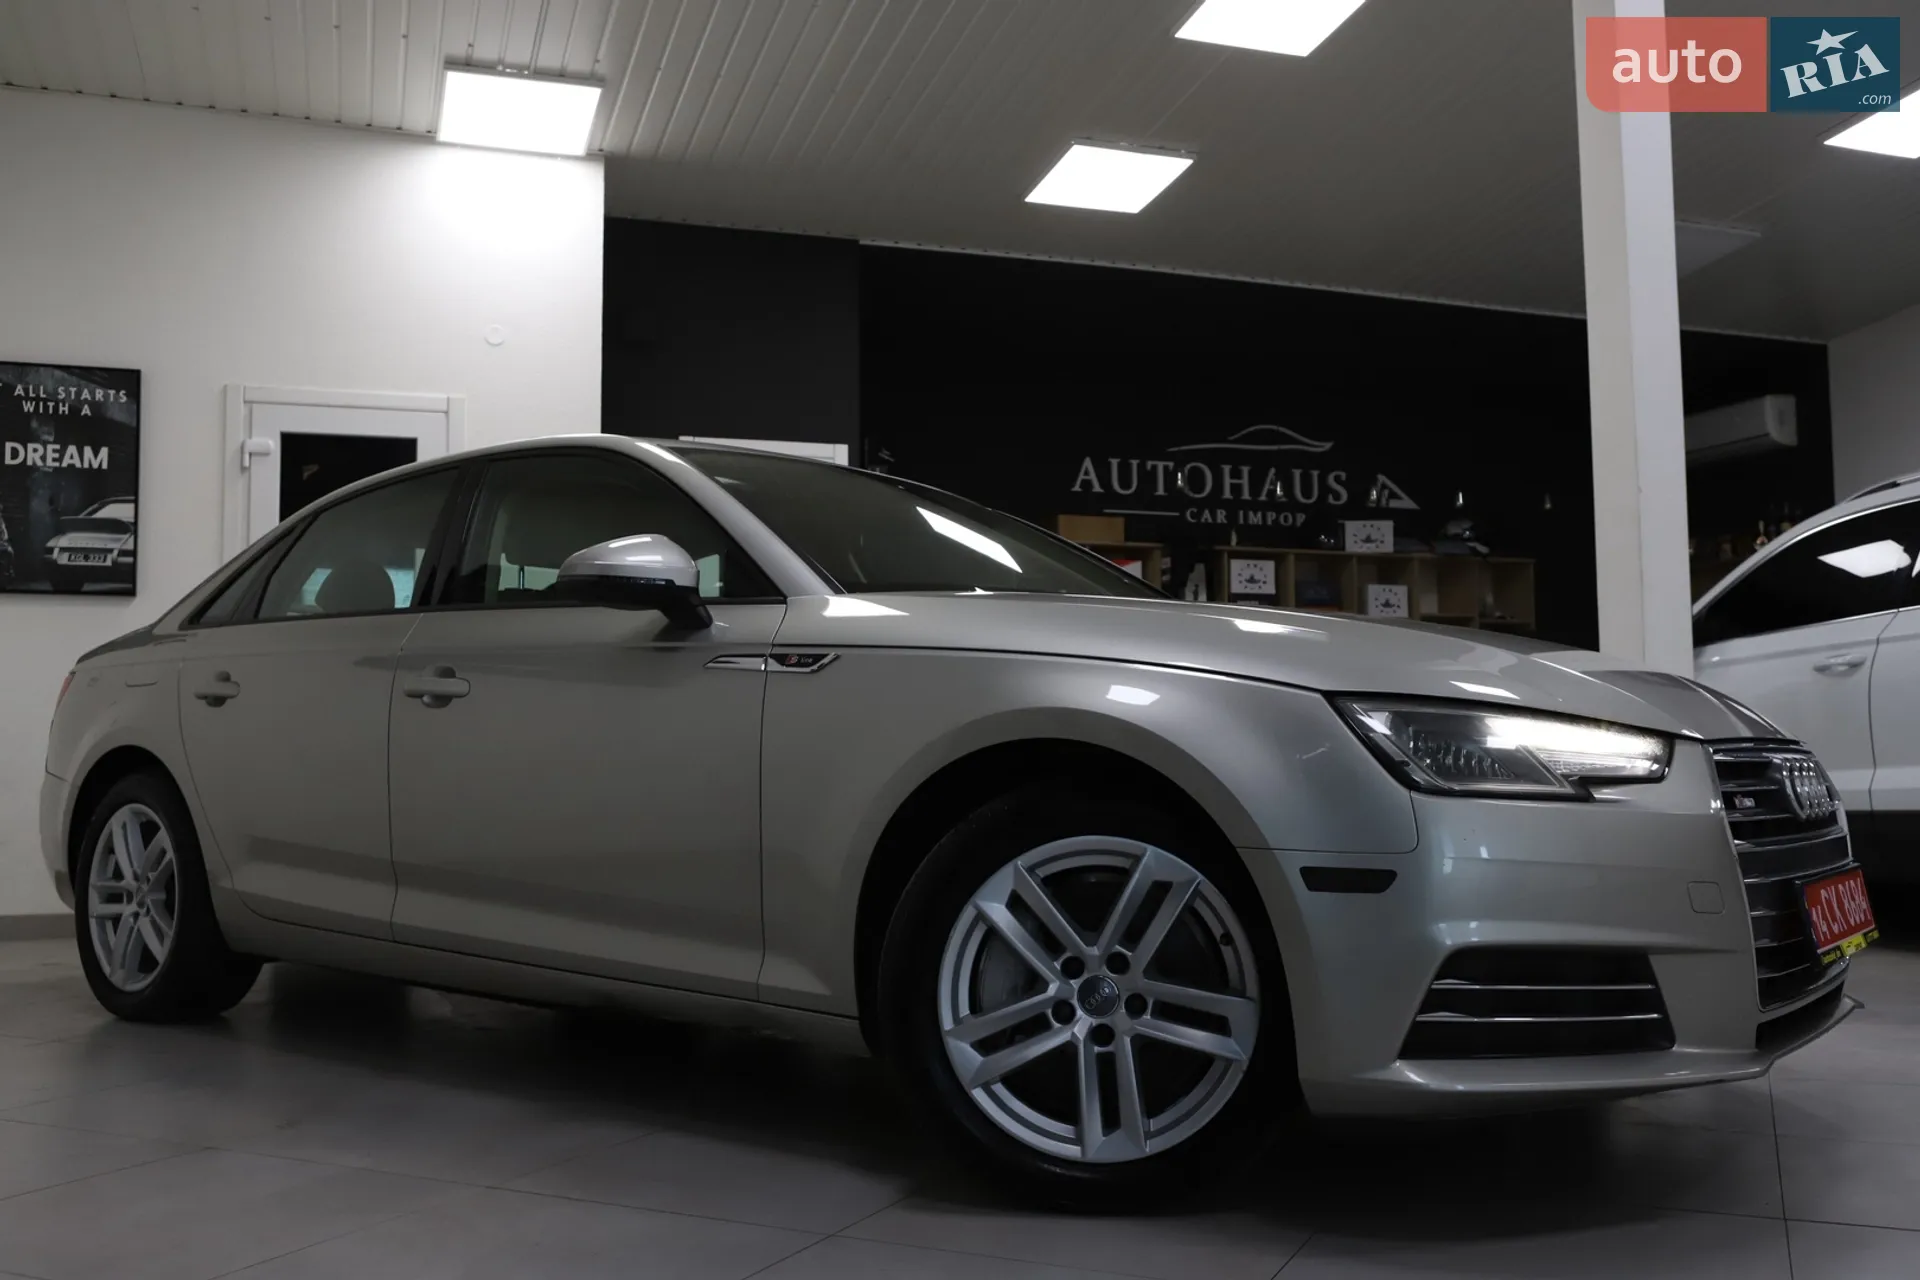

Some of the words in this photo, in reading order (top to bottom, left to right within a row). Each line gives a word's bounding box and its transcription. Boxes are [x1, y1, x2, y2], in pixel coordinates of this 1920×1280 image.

[13, 384, 47, 398] ALL
[57, 386, 127, 403] STARTS
[22, 400, 69, 415] WITH
[80, 404, 92, 416] A
[4, 441, 109, 470] DREAM
[1070, 456, 1349, 506] AUTOHAUS
[1185, 507, 1228, 524] CAR
